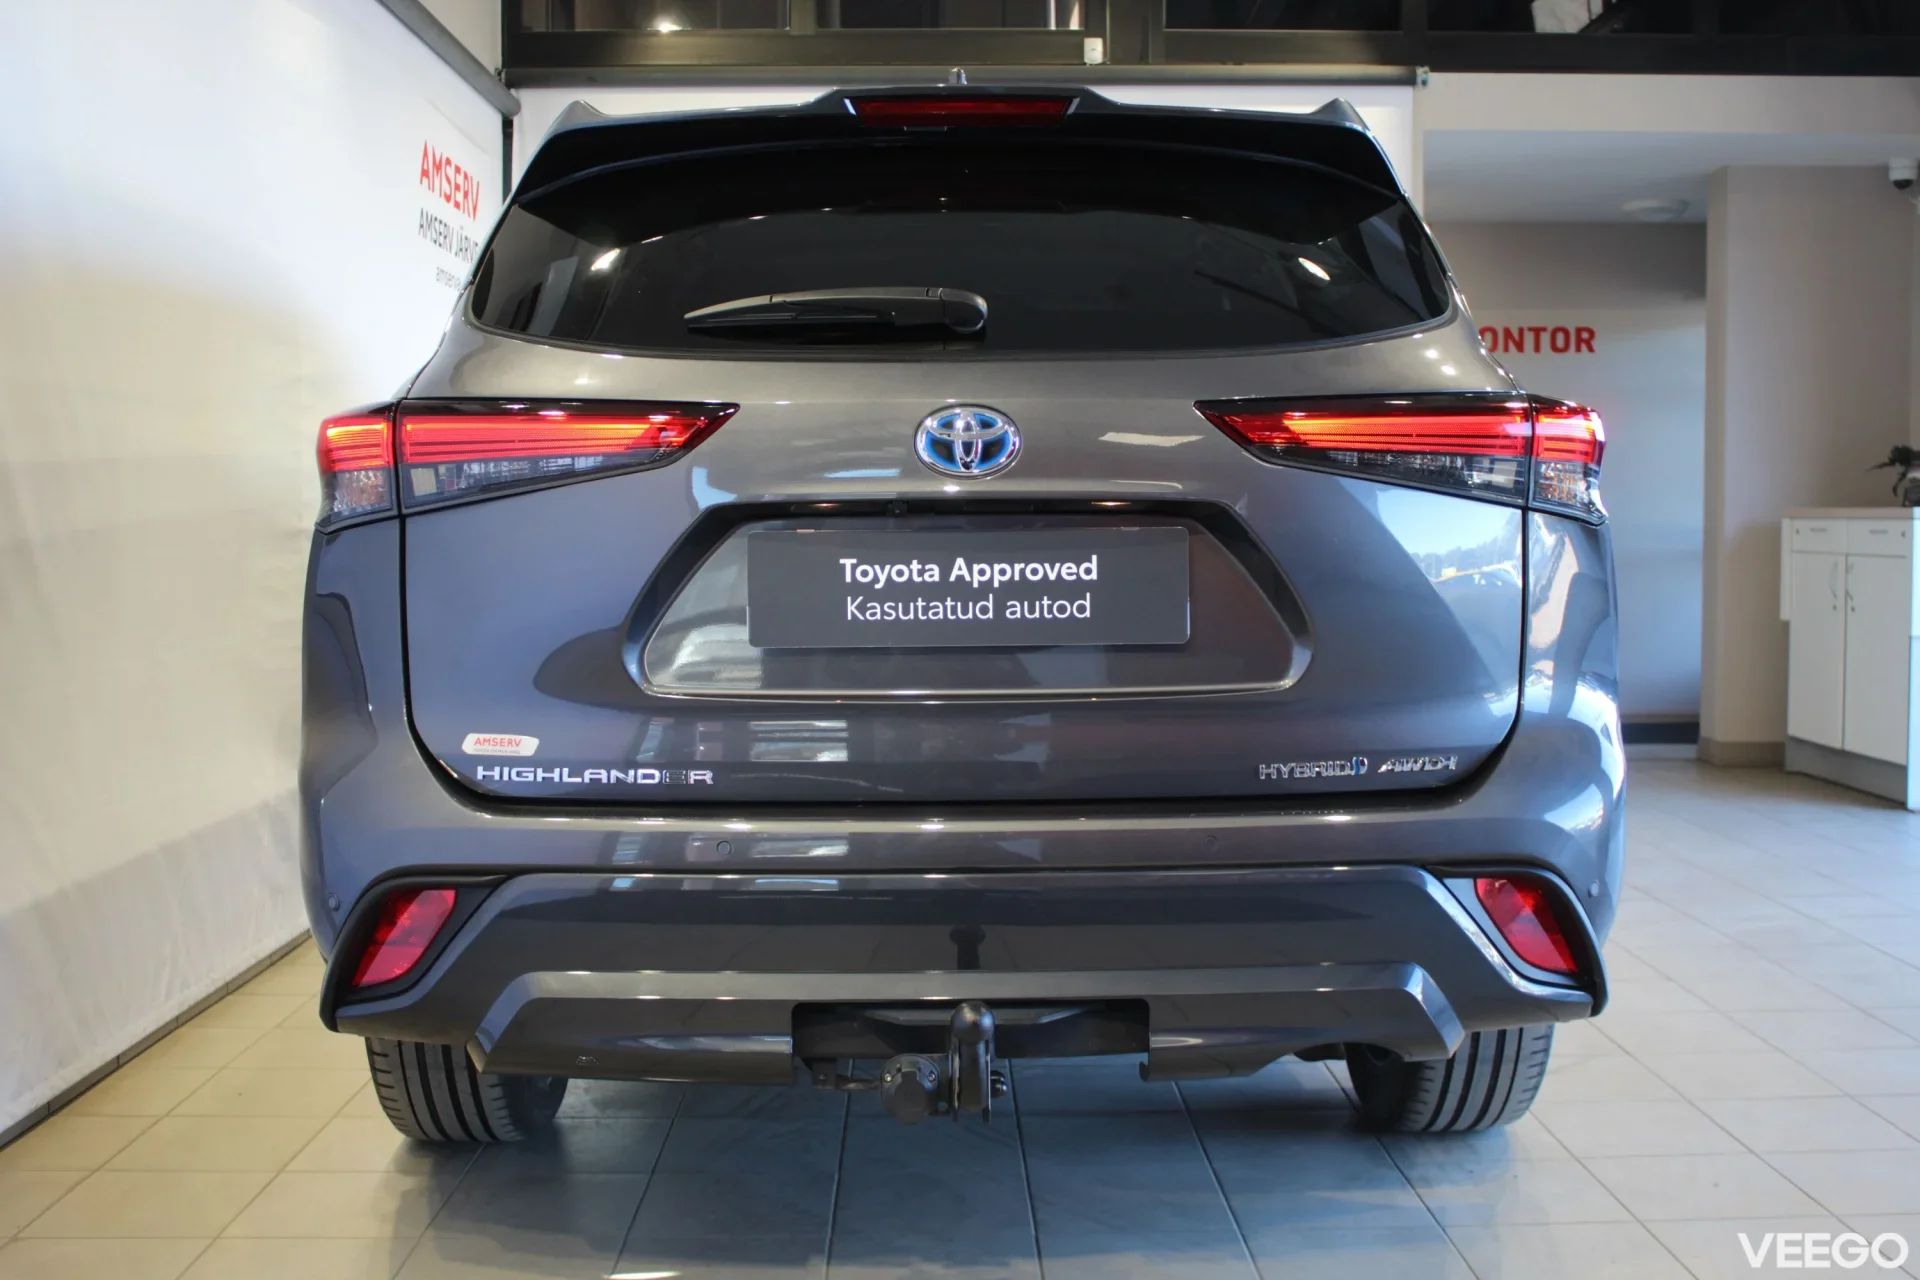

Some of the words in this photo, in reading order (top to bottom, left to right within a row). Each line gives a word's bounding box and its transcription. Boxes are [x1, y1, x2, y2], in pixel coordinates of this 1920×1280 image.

[419, 139, 480, 221] AMSERV
[418, 207, 454, 254] AMSERV
[839, 558, 940, 588] Toyota
[949, 555, 1098, 587] Approved
[846, 594, 994, 620] Kasutatud
[1005, 593, 1091, 618] autod
[474, 737, 522, 747] AMSERV
[477, 766, 714, 785] HIGHLANDER
[1259, 761, 1352, 780] HYBRID
